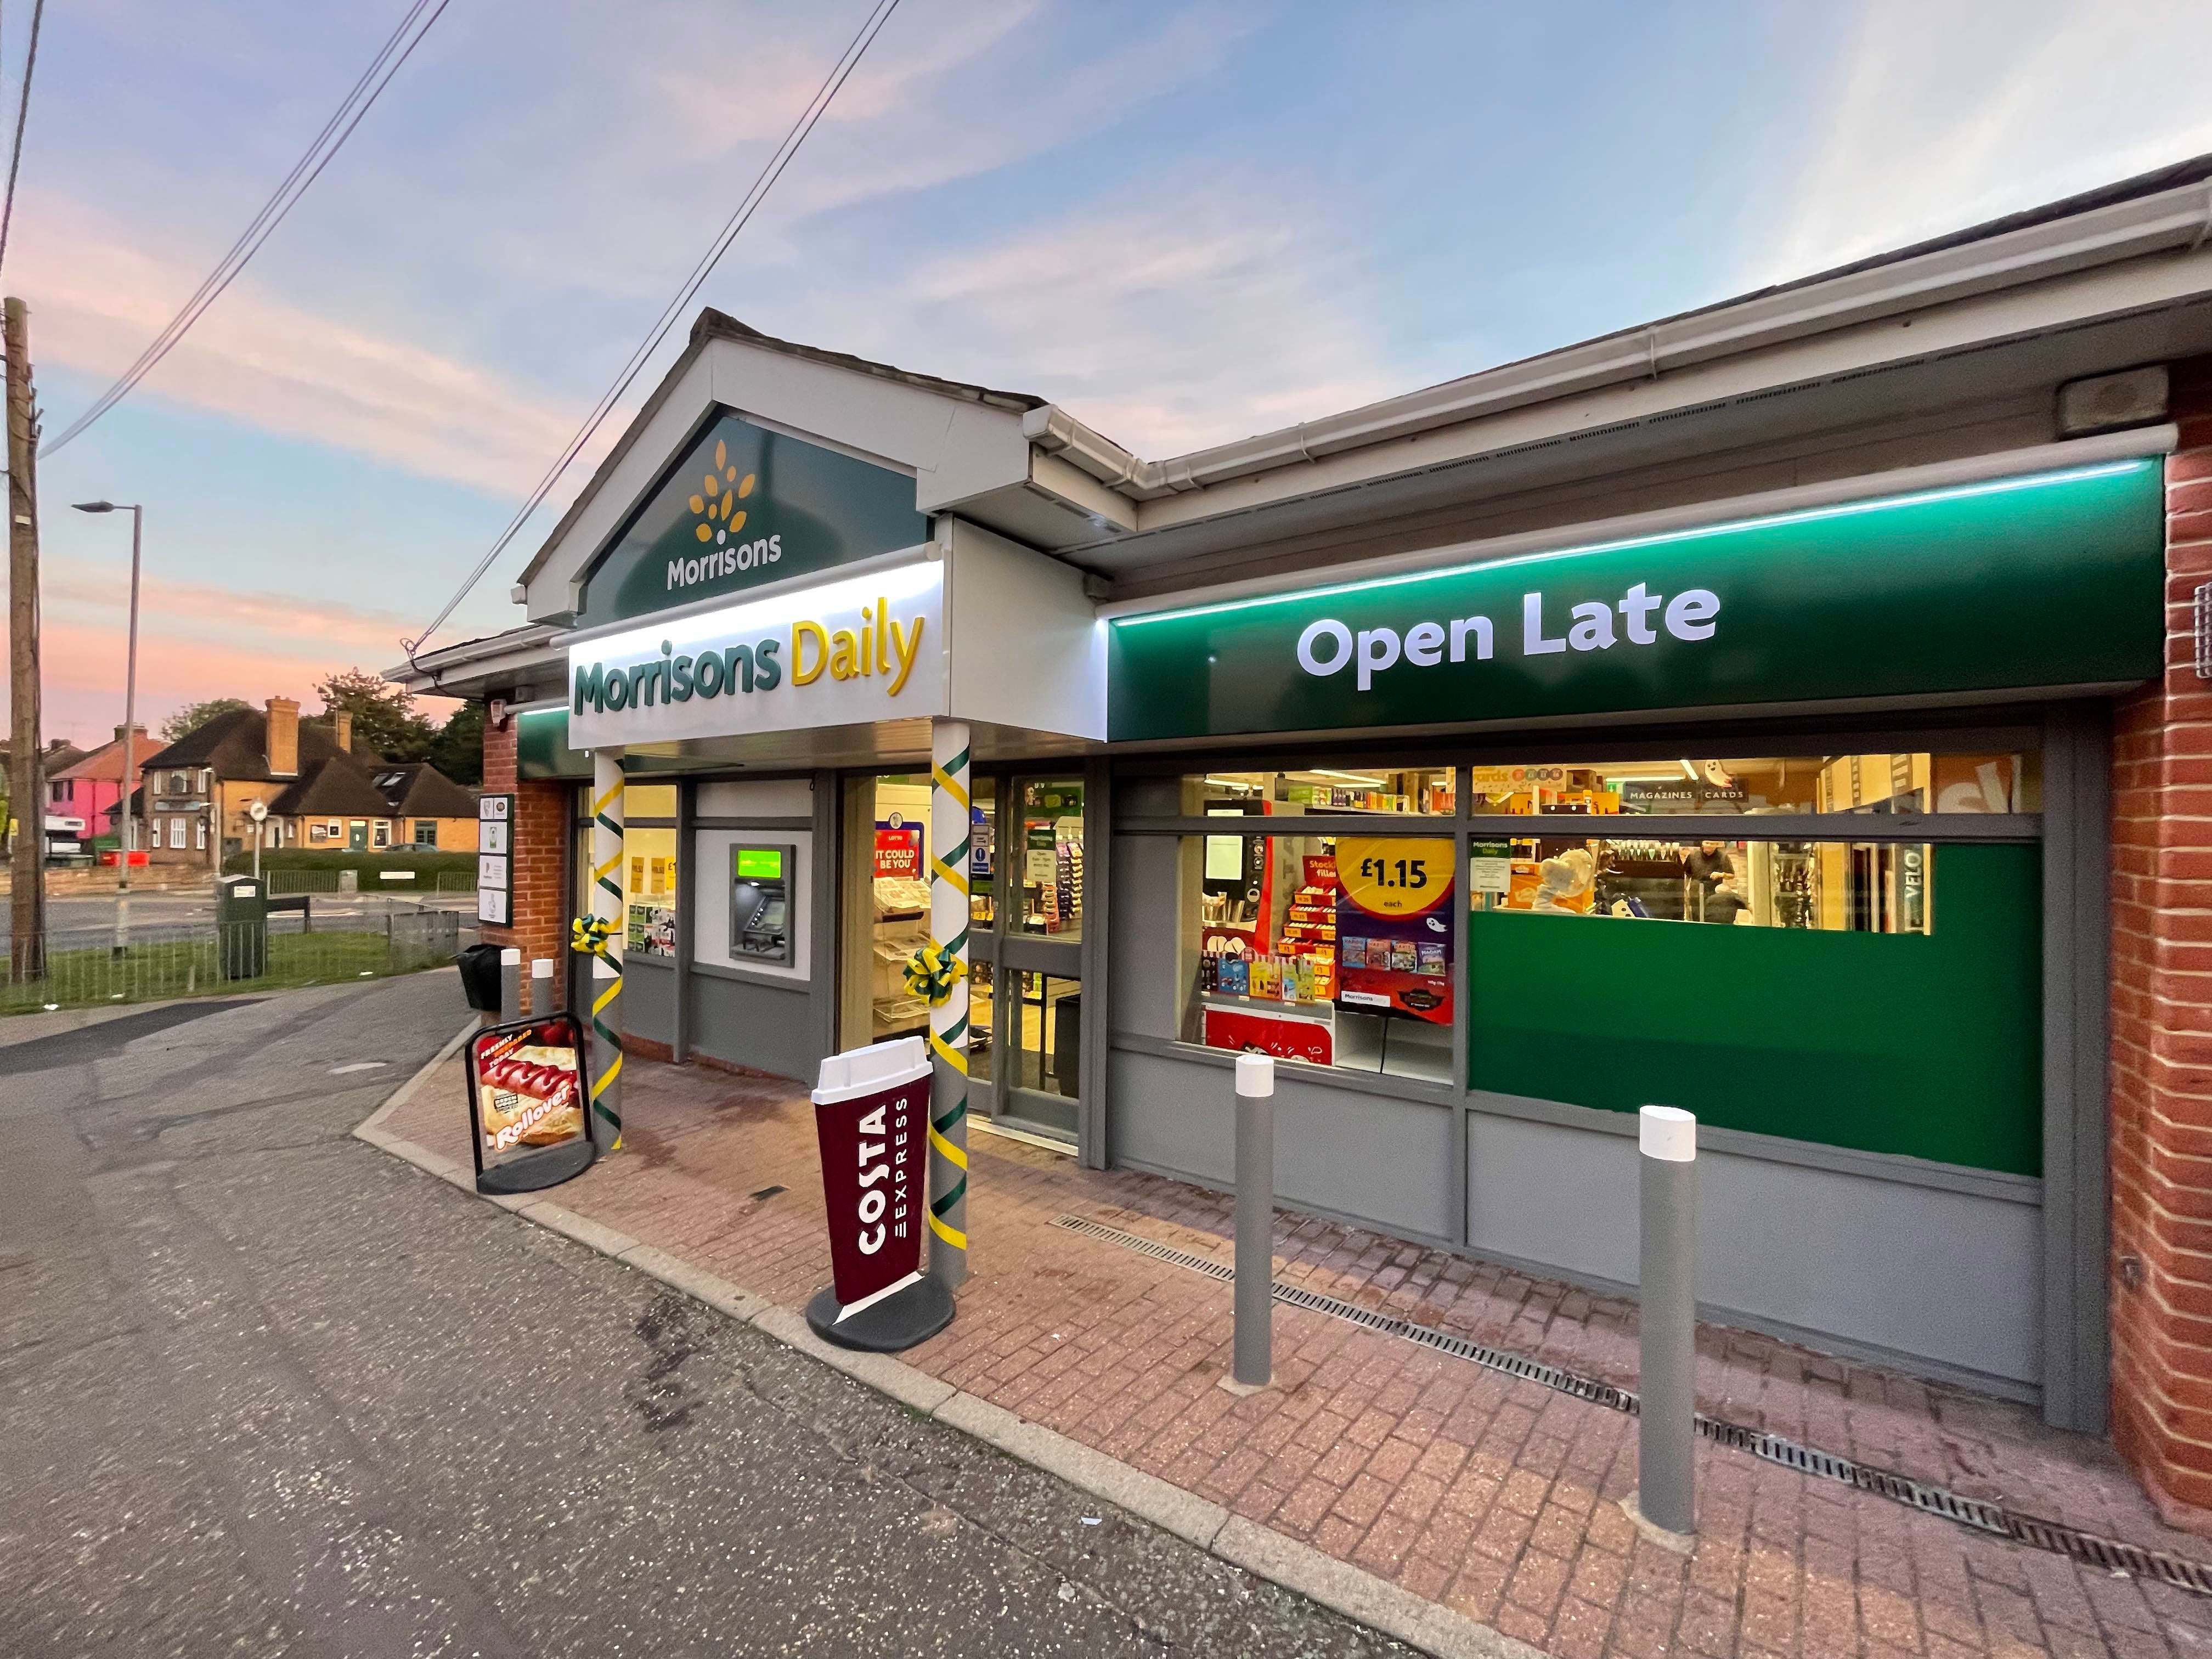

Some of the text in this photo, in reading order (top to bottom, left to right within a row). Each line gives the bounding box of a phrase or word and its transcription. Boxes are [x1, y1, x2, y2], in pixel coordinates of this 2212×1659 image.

[667, 529, 782, 590] Morrisons
[574, 596, 926, 716] Morrisons Daily
[1296, 582, 1721, 691] Open Late
[876, 849, 915, 860] IT COULD
[880, 859, 911, 870] BE YOU
[1360, 857, 1427, 889] £1.15
[1905, 852, 1922, 898] VELO
[1344, 994, 1374, 1002] Morrisons
[481, 1034, 513, 1059] FRESHLY
[489, 1047, 514, 1068] TODAY
[495, 1084, 571, 1150] Rollover
[858, 1104, 890, 1256] COSTA
[895, 1098, 907, 1220] EXPRESS
